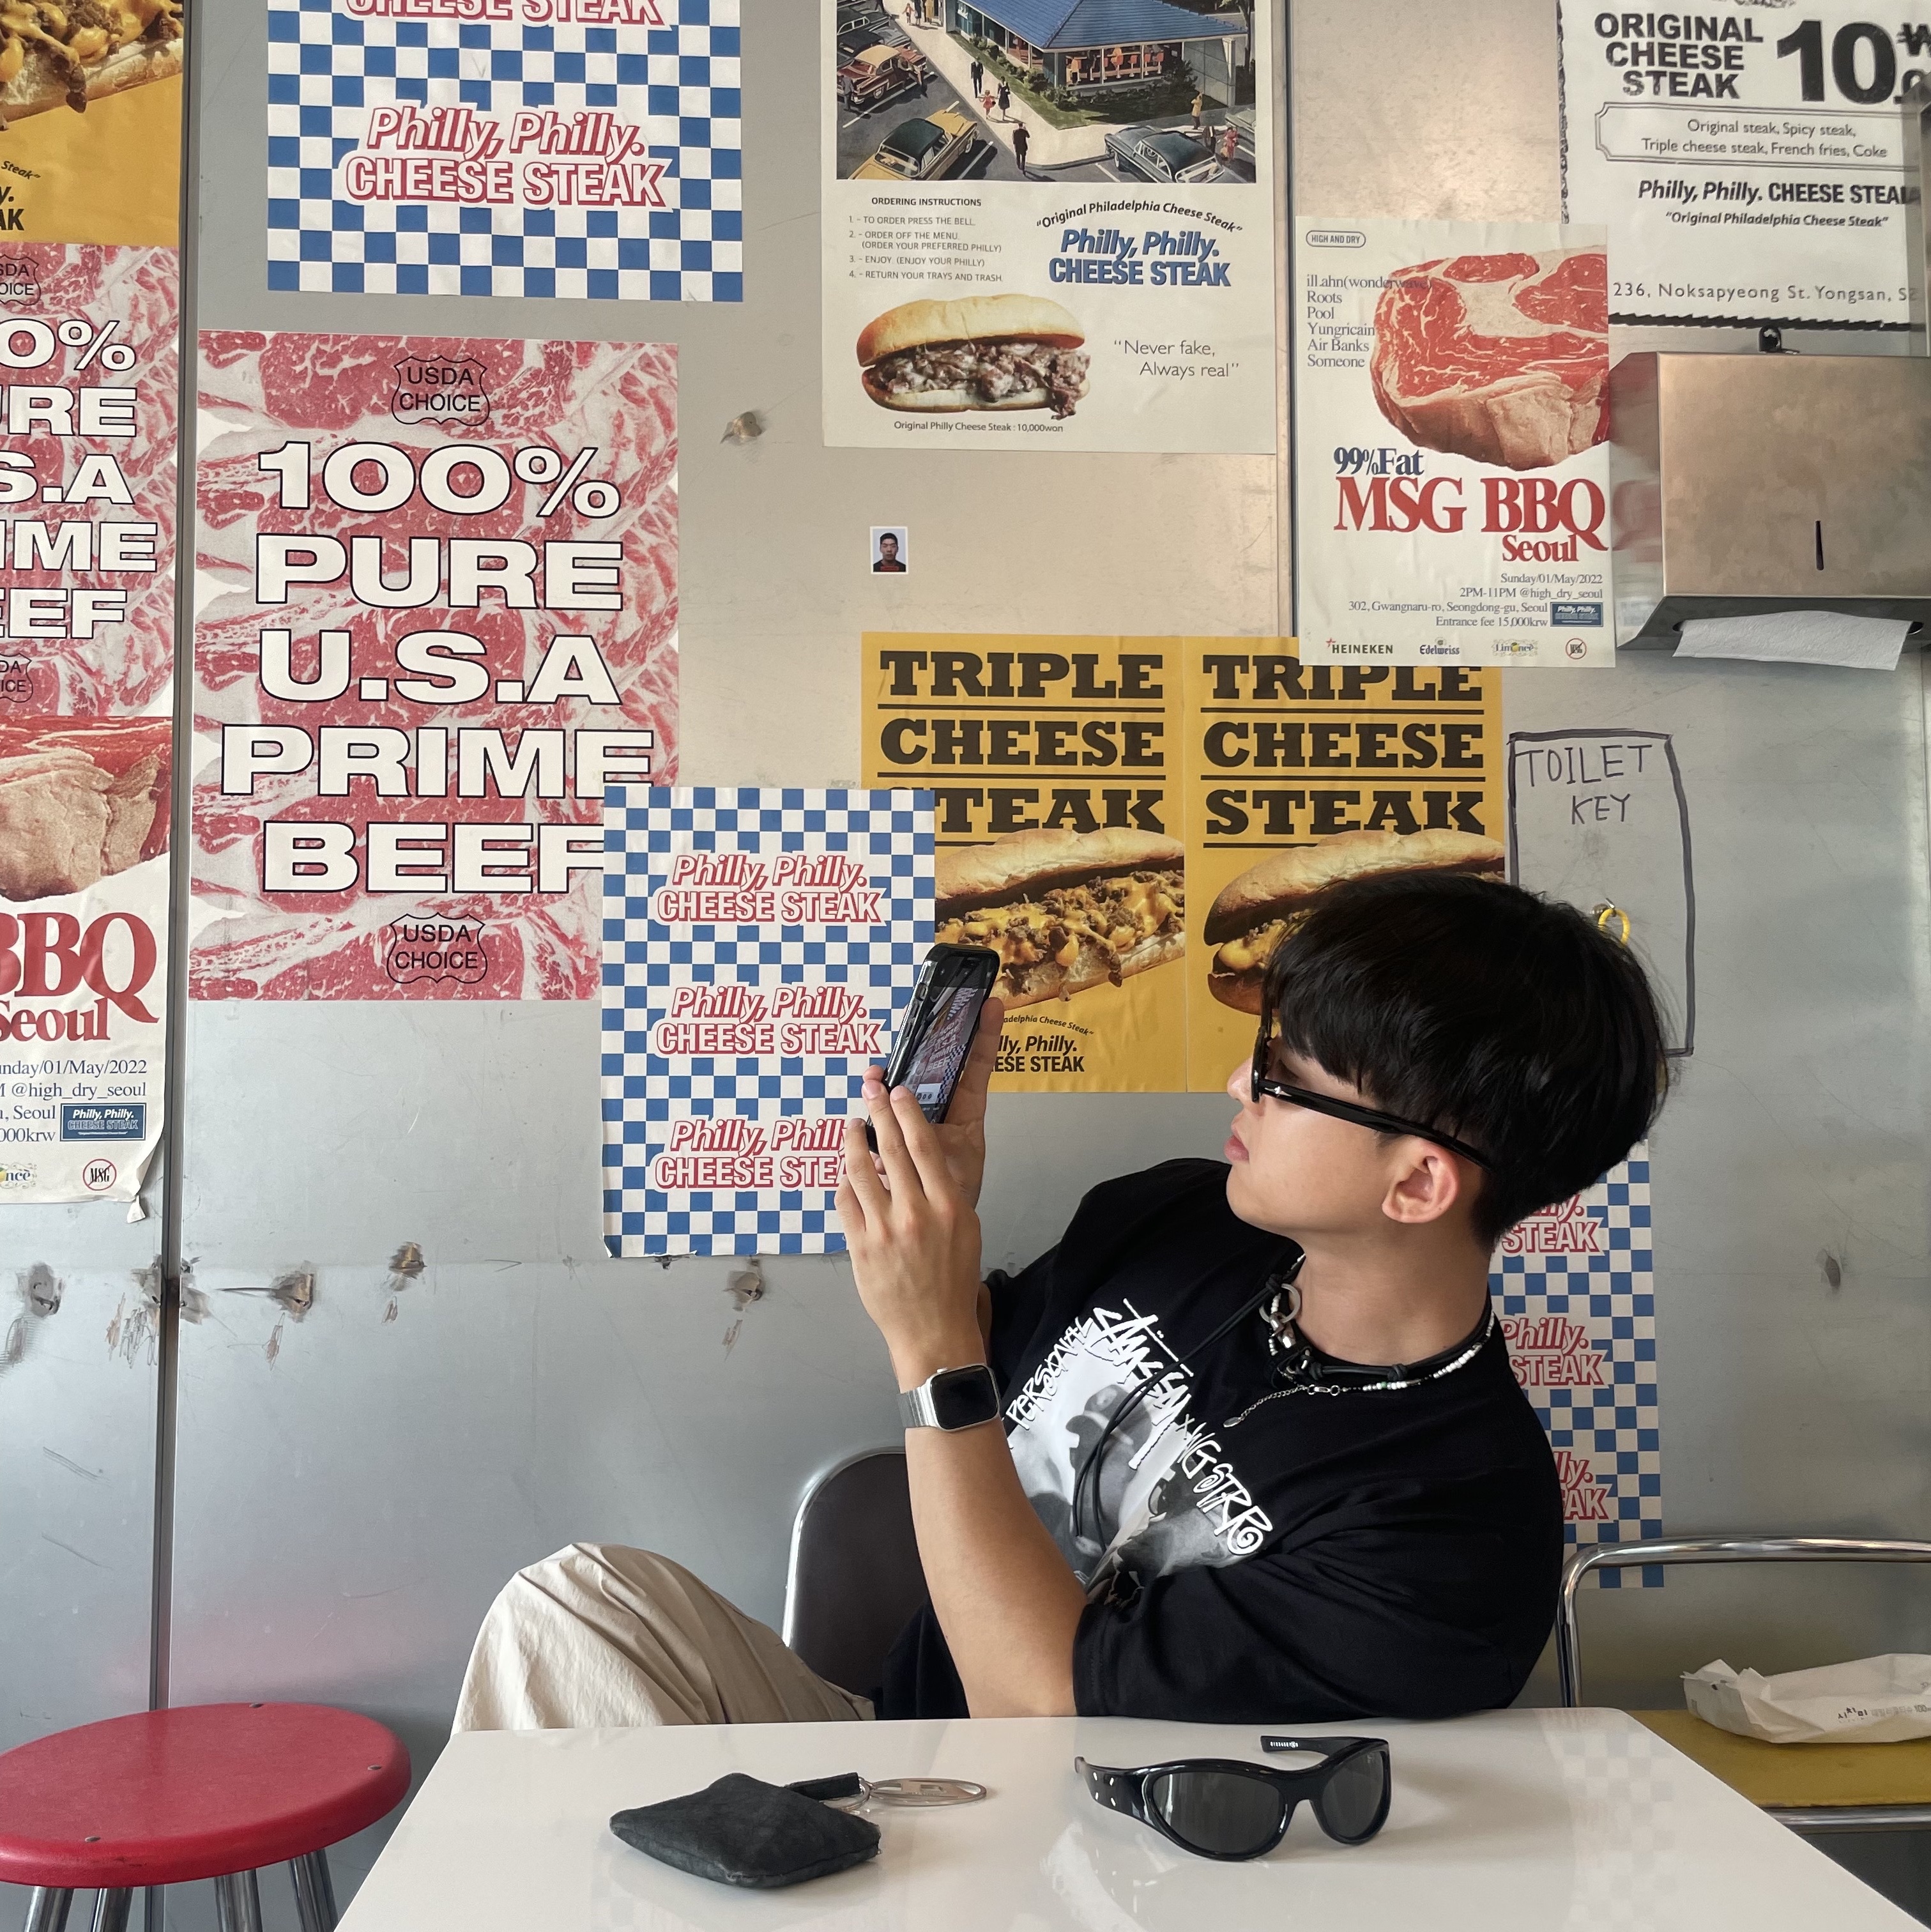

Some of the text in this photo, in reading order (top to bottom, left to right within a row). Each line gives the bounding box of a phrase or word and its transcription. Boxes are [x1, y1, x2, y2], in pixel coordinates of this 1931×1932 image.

[1594, 12, 1764, 43] ORIGINAL
[1605, 41, 1745, 71] CHEESE
[1622, 70, 1739, 99] STEAK
[367, 105, 645, 164] Philly, Philly.
[1688, 118, 1856, 138] Original steak, Spicy steak,
[1641, 137, 1887, 158] Triple cheese steak, French fries, Coke
[346, 157, 666, 207] CHEESE STEAK
[872, 197, 981, 206] ORDERING INSTRUCTIONS
[1638, 180, 1697, 205] Philly,
[1702, 181, 1762, 206] Philly.
[1768, 183, 1844, 203] CHEESE
[1088, 200, 1161, 213] Philadelphia
[1163, 203, 1203, 219] Cheese
[1723, 213, 1800, 227] Philadelphia
[1803, 215, 1845, 227] Cheese
[862, 241, 893, 249] (ORDER
[922, 242, 969, 251] PREFERRED
[971, 243, 1002, 253] PHILLY)
[1060, 228, 1219, 263] Philly, Philly.
[1311, 235, 1361, 244] HIGH AND DRY
[896, 256, 926, 265] (ENJOY
[929, 257, 952, 265] YOUR
[954, 257, 985, 267] PHILLY)
[1049, 257, 1232, 287] CHEESE STEAK
[866, 270, 898, 279] RETURN
[901, 272, 924, 280] YOUR
[927, 272, 952, 280] TRAYS
[955, 273, 973, 281] AND
[1307, 290, 1343, 304] Roots
[1612, 282, 1892, 303] 236, Noksapyeong St. Yongsan,
[1307, 306, 1334, 319] Pool
[1308, 322, 1376, 339] Yungricain
[1179, 341, 1216, 357] fake,
[1308, 338, 1370, 351] Air Banks
[1140, 361, 1195, 380] Always
[1308, 355, 1366, 368] Someone
[407, 366, 474, 386] USDA
[399, 392, 480, 413] CHOICE
[894, 421, 929, 433] Original
[930, 422, 954, 433] Philly
[955, 422, 987, 432] Cheese
[1017, 423, 1064, 434] 10,000won
[257, 440, 621, 519] 100%
[1334, 477, 1609, 551] MSG BBQ
[1502, 534, 1579, 562] Seoul
[256, 533, 624, 611] PURE
[1500, 574, 1603, 586] Sunday/01/May/2022
[1460, 587, 1603, 600] 2PM-11PM @high_dry_seoul
[1348, 601, 1370, 613] 302,
[1371, 601, 1444, 613] Gwangnaru-ro,
[1446, 602, 1518, 615] Seongdong-gu,
[1521, 602, 1548, 613] Seoul
[1436, 617, 1548, 628] Entrance fee 15,000krw
[1331, 641, 1460, 656] HEINEKEN Edelweiss
[258, 629, 623, 705] U.S.A
[880, 650, 1164, 699] TRIPLE
[1202, 654, 1484, 701] TRIPLE
[880, 717, 1164, 767] CHEESE
[1203, 721, 1484, 769] CHEESE
[222, 724, 654, 799] PRIME
[1515, 744, 1652, 787] TOILET
[935, 788, 1165, 833] TEAK
[1205, 789, 1485, 836] STEAK
[1571, 793, 1631, 825] KEY
[263, 820, 604, 894] BEEF
[672, 854, 867, 892] Philly, Philly.
[657, 891, 882, 923] CHEESE STEAK
[403, 924, 471, 943] USDA
[395, 951, 478, 970] CHOICE
[671, 986, 867, 1023] Philly, Philly.
[1004, 1015, 1037, 1024] adelphia
[1039, 1016, 1067, 1027] Cheese
[655, 1023, 881, 1056] CHEESE STEAK
[1025, 1035, 1078, 1056] Philly.
[1030, 1056, 1085, 1072] STEAK
[11, 1082, 146, 1101] @high_dry_seoul
[13, 1105, 56, 1119] Seoul
[73, 1109, 135, 1121] Philly, Philly.
[68, 1120, 139, 1130] CHEESE STEAK
[670, 1119, 767, 1156] Philly,
[655, 1156, 774, 1188] CHEESE
[1502, 1222, 1600, 1254] STEAK
[1501, 1317, 1589, 1353] Philly.
[1511, 1354, 1604, 1386] STEAK
